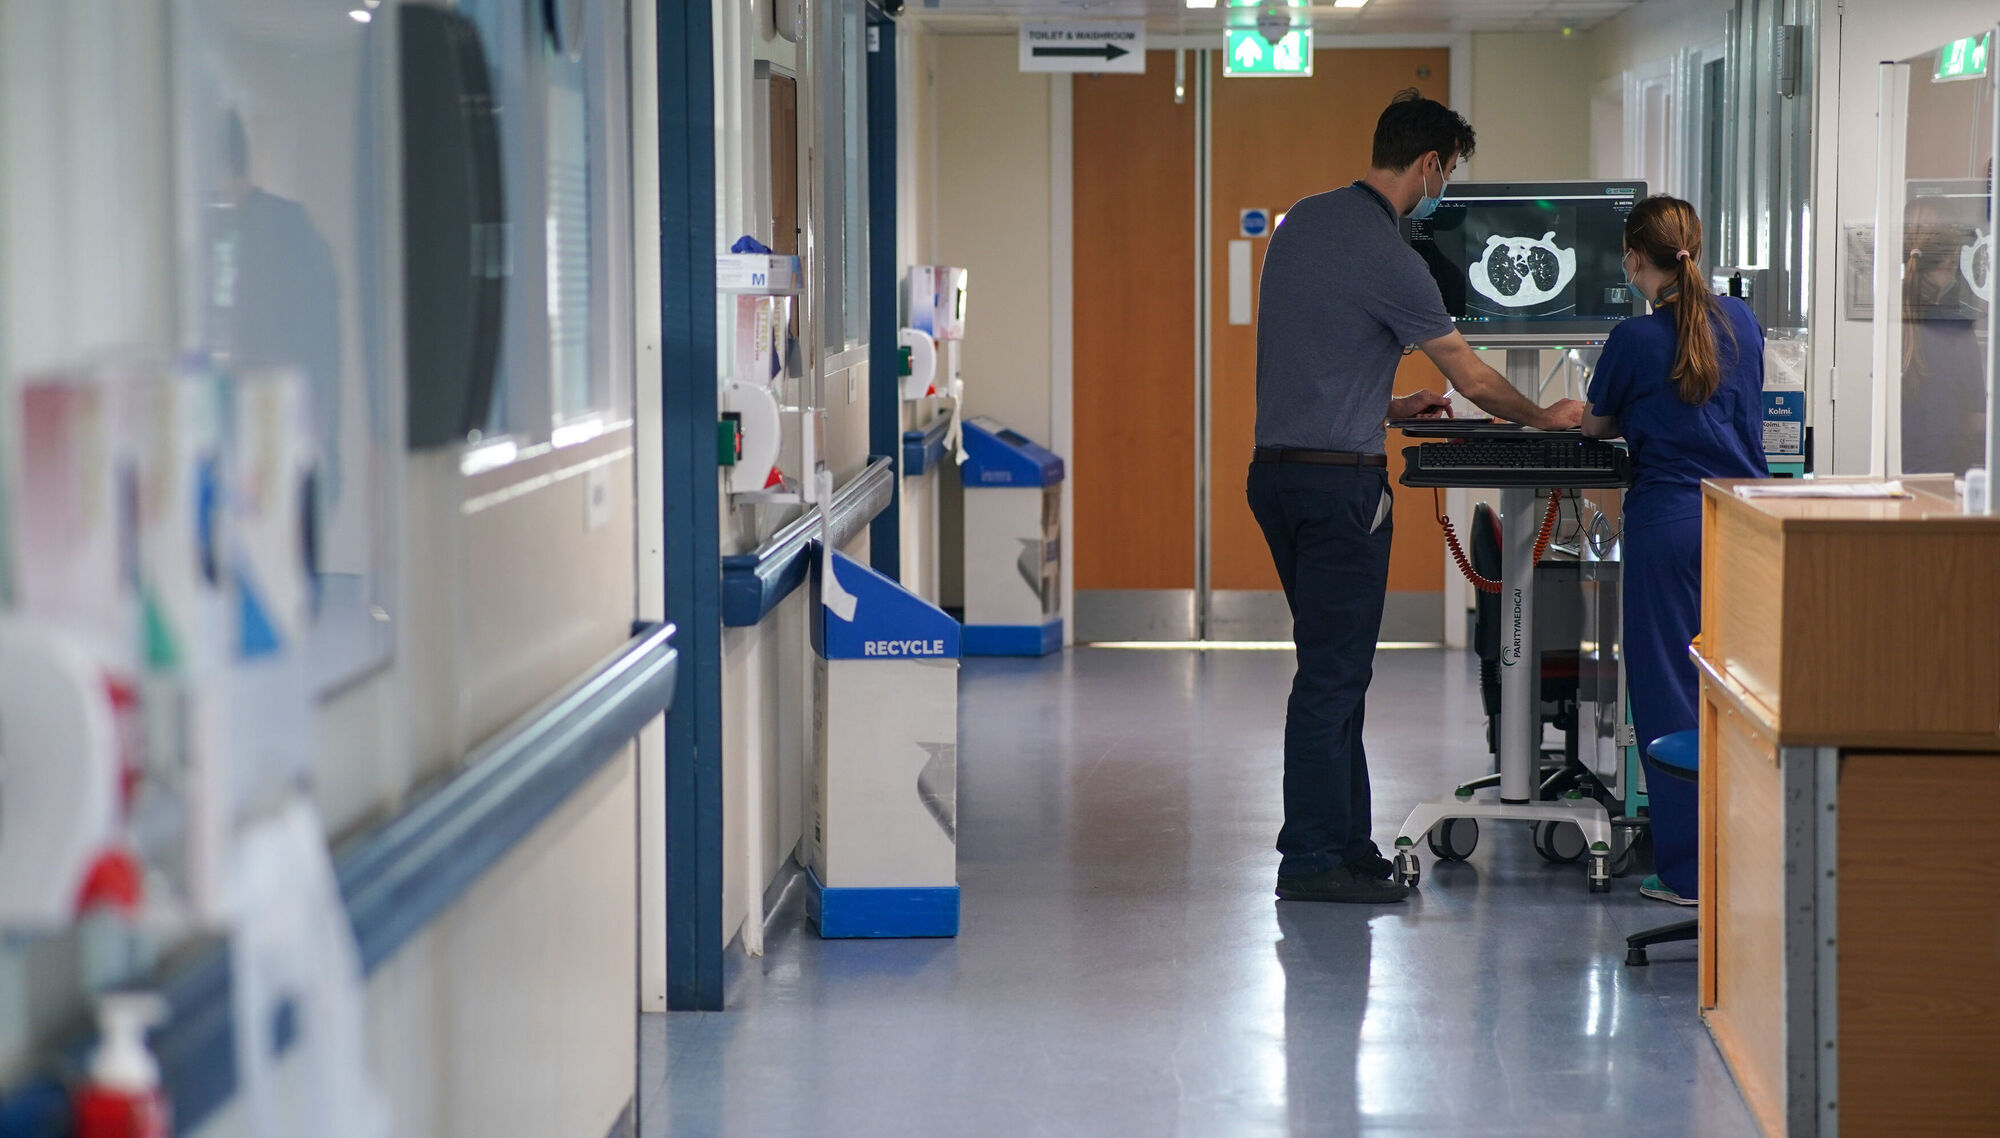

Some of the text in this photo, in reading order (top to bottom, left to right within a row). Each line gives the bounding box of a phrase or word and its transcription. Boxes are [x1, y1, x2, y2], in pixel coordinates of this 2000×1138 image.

[1029, 31, 1135, 40] TOILET & WASHROOM
[752, 273, 765, 286] M
[864, 640, 944, 656] RECYCLE
